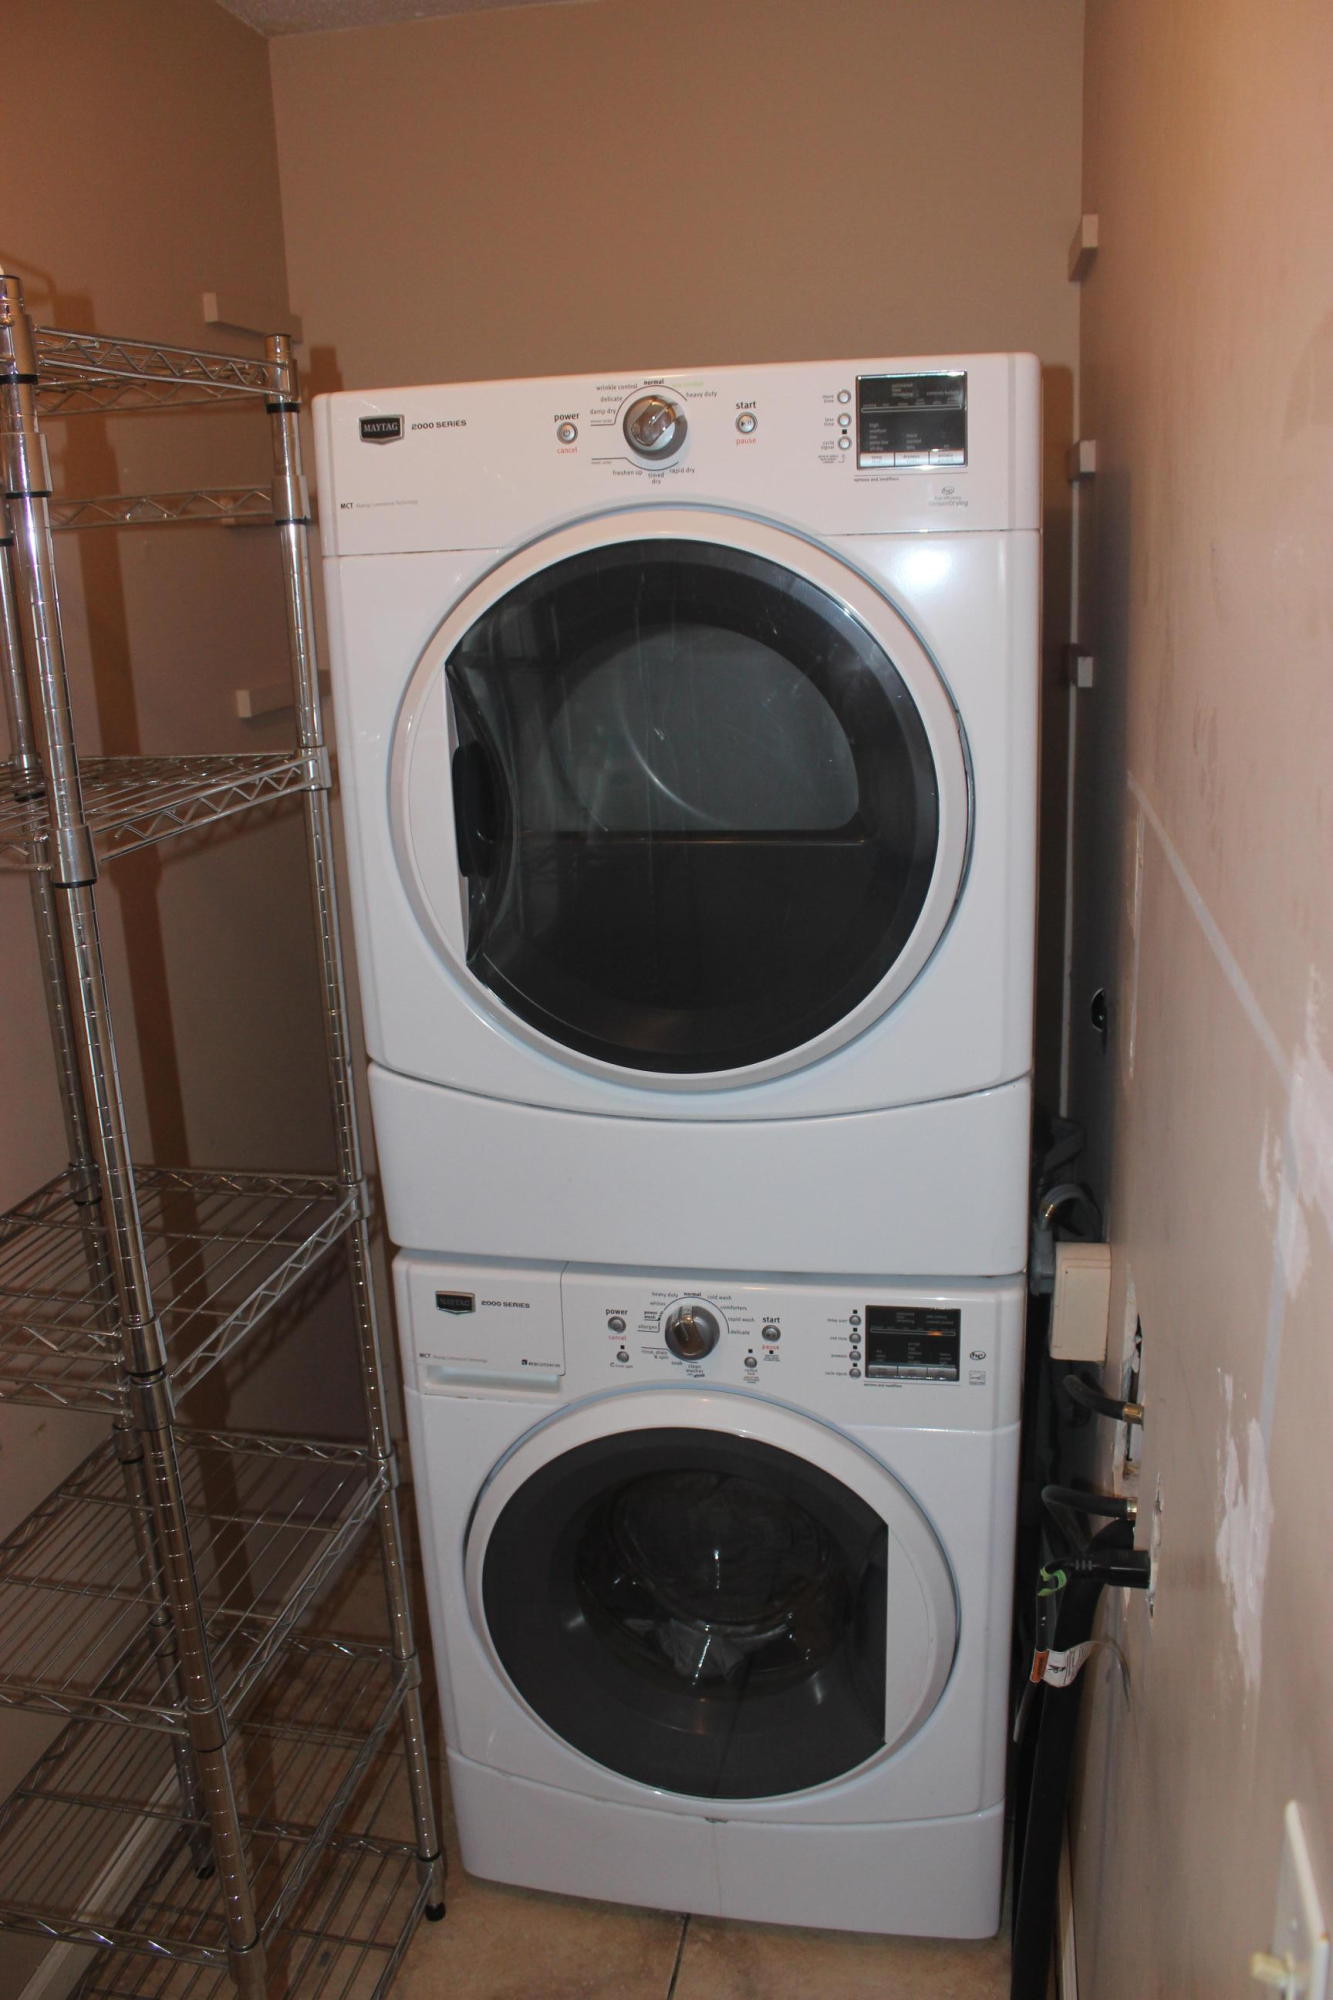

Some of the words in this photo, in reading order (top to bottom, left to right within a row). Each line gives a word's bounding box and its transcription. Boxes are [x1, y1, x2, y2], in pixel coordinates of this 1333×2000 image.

[643, 378, 665, 386] normal
[686, 391, 703, 399] heavy
[704, 390, 718, 398] duty
[600, 395, 623, 403] delicate
[736, 401, 757, 409] start
[554, 412, 580, 423] power
[363, 421, 399, 433] MAYTAG
[411, 422, 434, 431] 2000
[436, 419, 467, 429] SERIES
[736, 437, 757, 446] pause
[556, 447, 578, 455] cancel
[340, 502, 354, 510] MCT
[503, 1301, 530, 1309] SERIES
[605, 1308, 628, 1317] power
